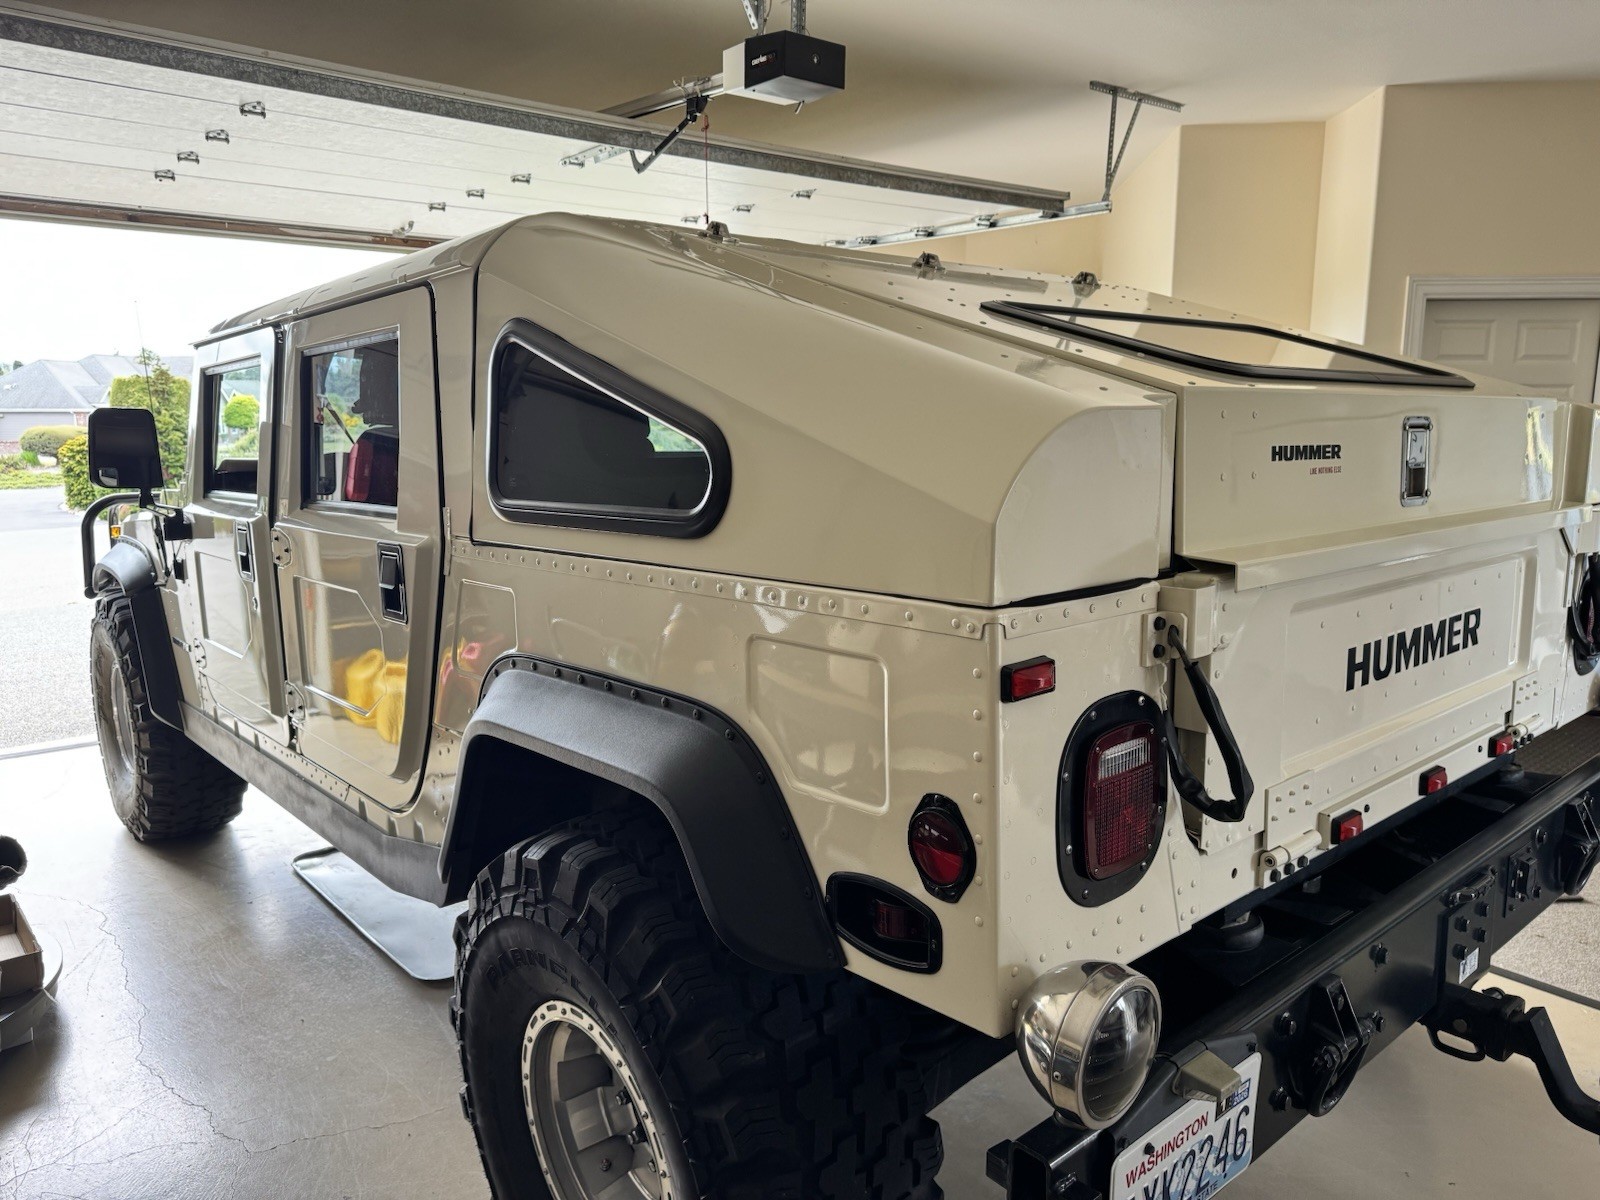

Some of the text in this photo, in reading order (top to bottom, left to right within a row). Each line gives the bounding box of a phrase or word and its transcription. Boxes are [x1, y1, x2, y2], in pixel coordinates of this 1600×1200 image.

[1271, 445, 1341, 461] HUMMER
[1346, 608, 1481, 692] HUMMER
[1126, 1111, 1209, 1188] WASHINGTON
[1127, 1105, 1250, 1200] K2246
